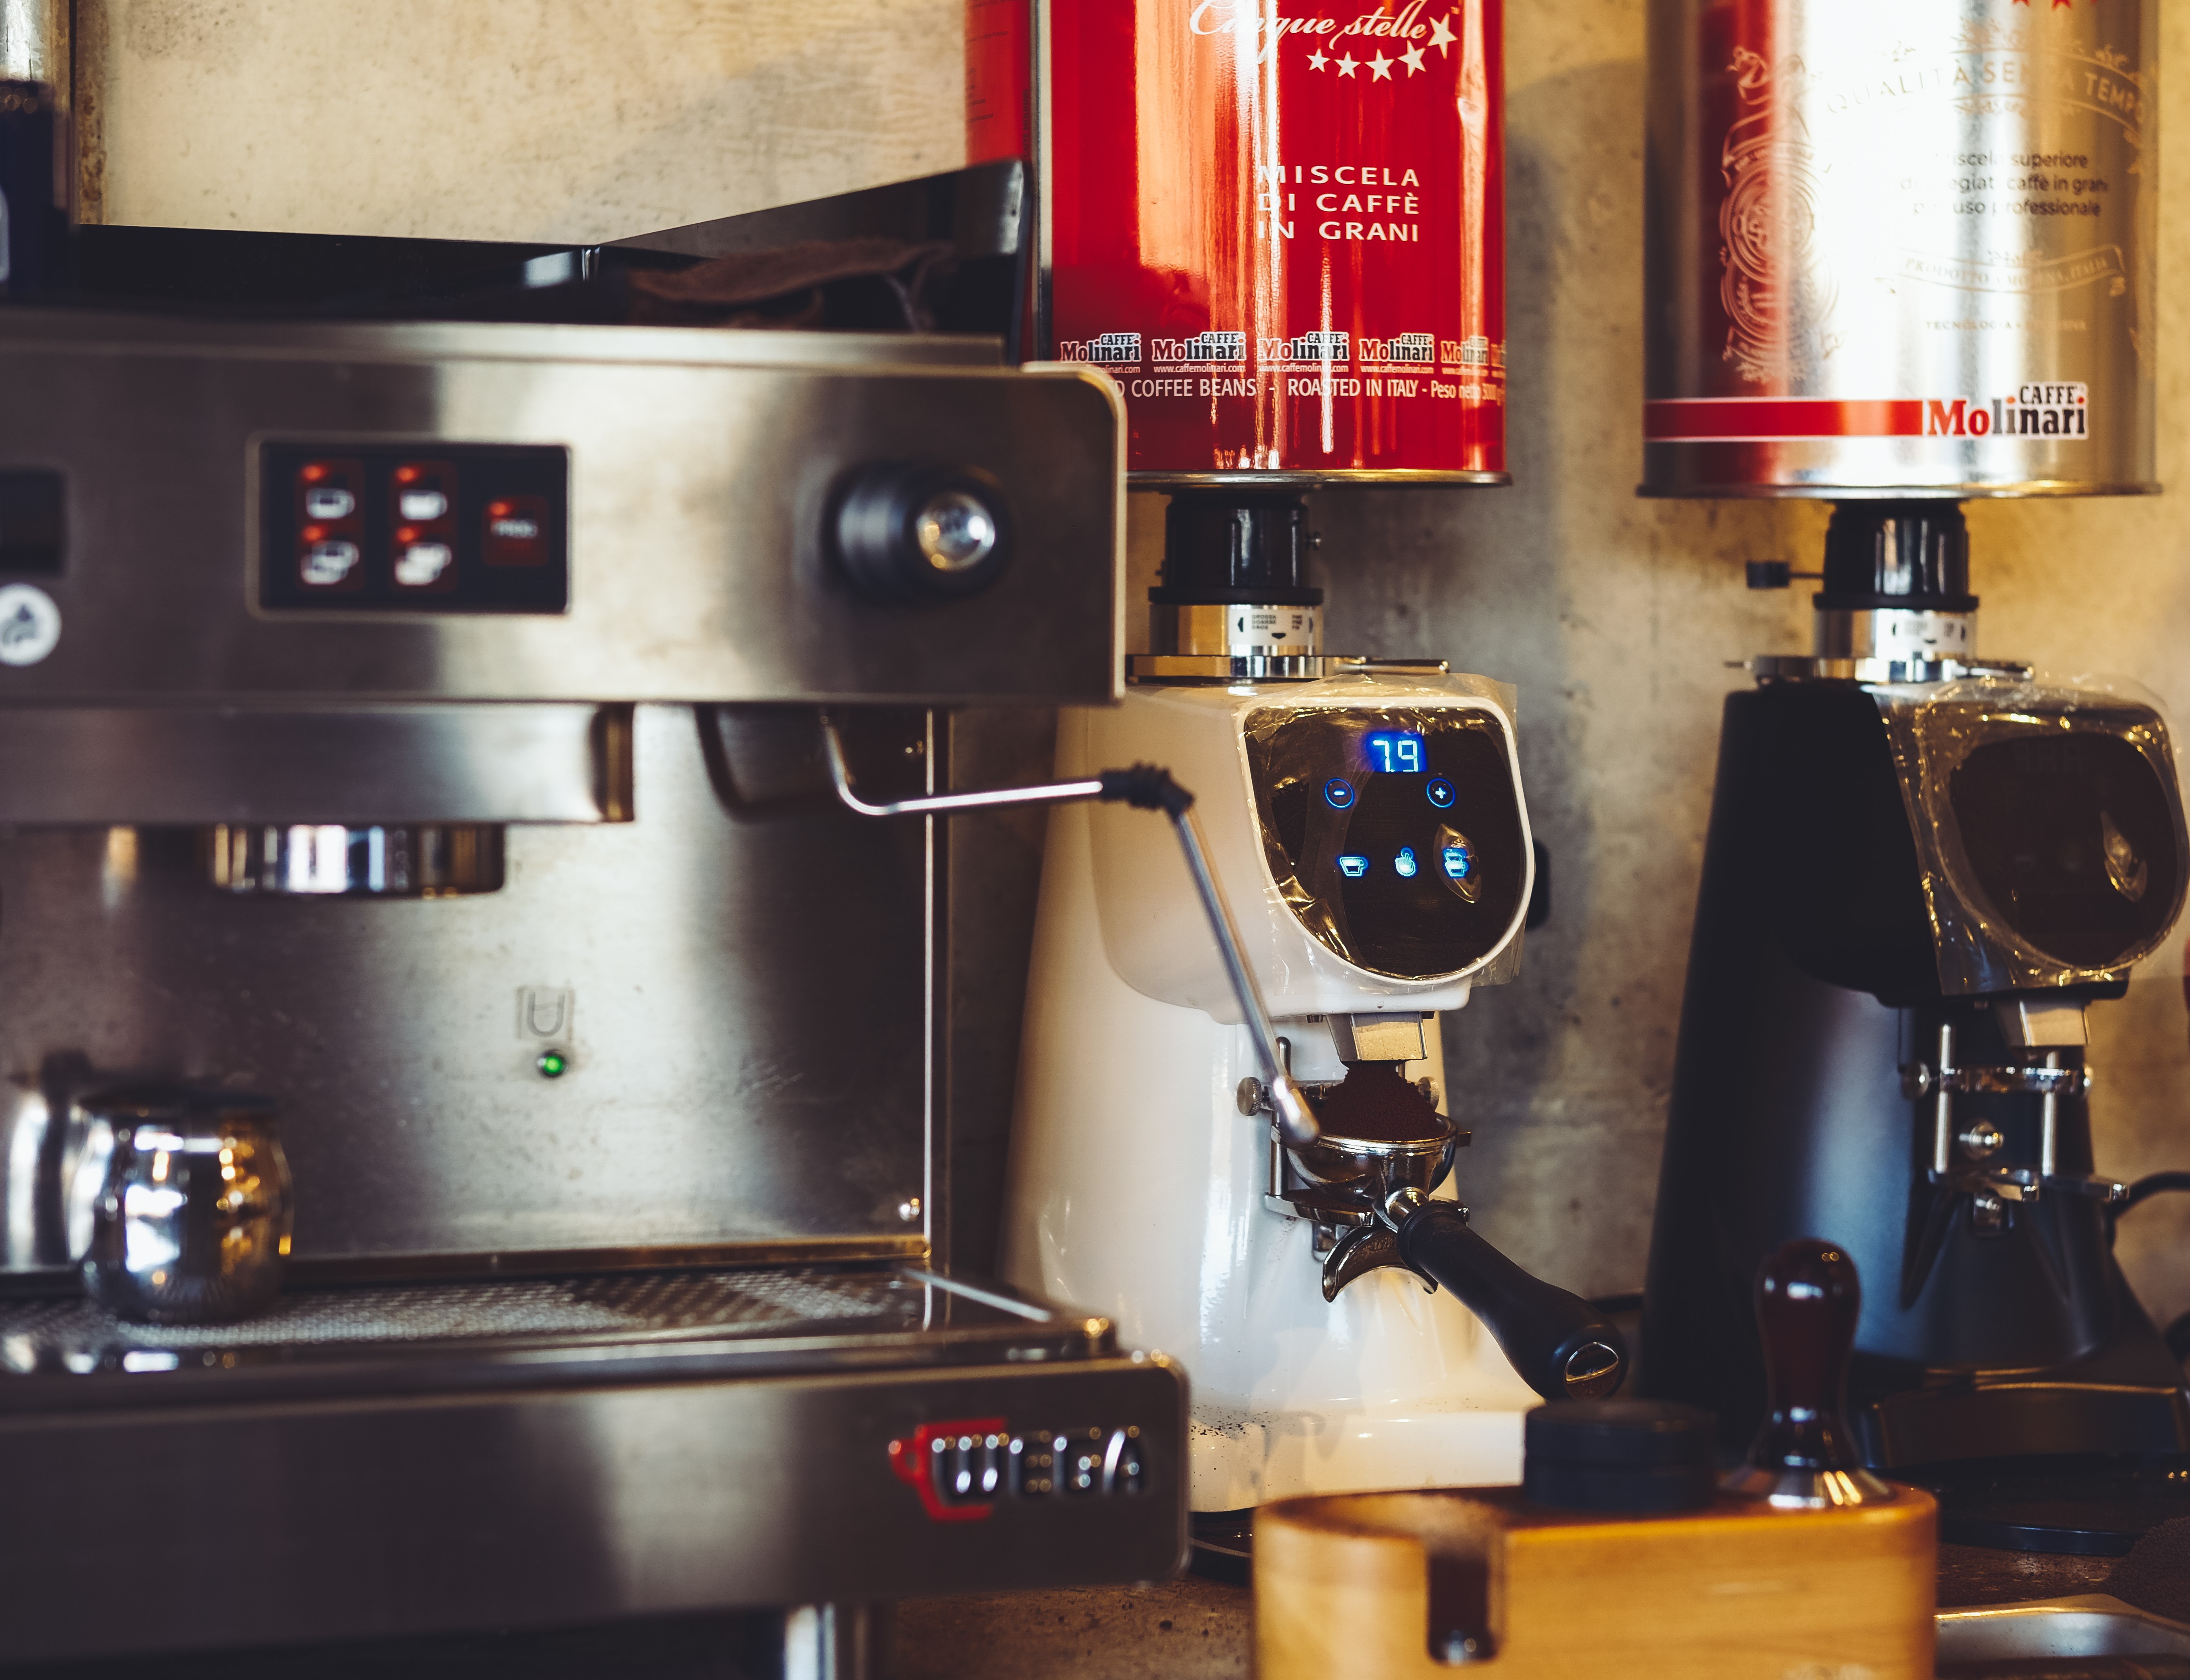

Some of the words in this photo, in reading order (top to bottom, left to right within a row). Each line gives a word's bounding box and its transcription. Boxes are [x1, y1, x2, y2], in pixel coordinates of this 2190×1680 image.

[1329, 0, 1427, 50] stelle
[1984, 61, 2074, 90] SEA
[1935, 147, 2003, 166] iscela
[2011, 151, 2089, 169] superiore
[1257, 165, 1420, 187] MISCELA
[2007, 174, 2049, 191] caffè
[2053, 175, 2068, 191] in
[1258, 193, 1295, 211] DI
[1316, 192, 1419, 214] CAFFÈ
[1953, 202, 1986, 214] uso
[1259, 221, 1295, 239] IN
[1318, 221, 1419, 242] GRANI
[1061, 339, 1140, 362] Molinari
[1153, 338, 1245, 360] Molinari
[1258, 338, 1348, 360] Molinari
[1361, 339, 1433, 361] Molinari
[1154, 363, 1246, 372] www.caffemolinari.com
[1258, 362, 1349, 372] www.caffemolin.com
[1131, 379, 1193, 397] COFFEE
[1200, 379, 1257, 397] BEANS
[1288, 378, 1361, 396] ROASTED
[1366, 379, 1382, 397] IN
[1387, 379, 1419, 397] ITALY
[1431, 380, 1457, 398] Peso
[1927, 396, 2085, 435] Molinari
